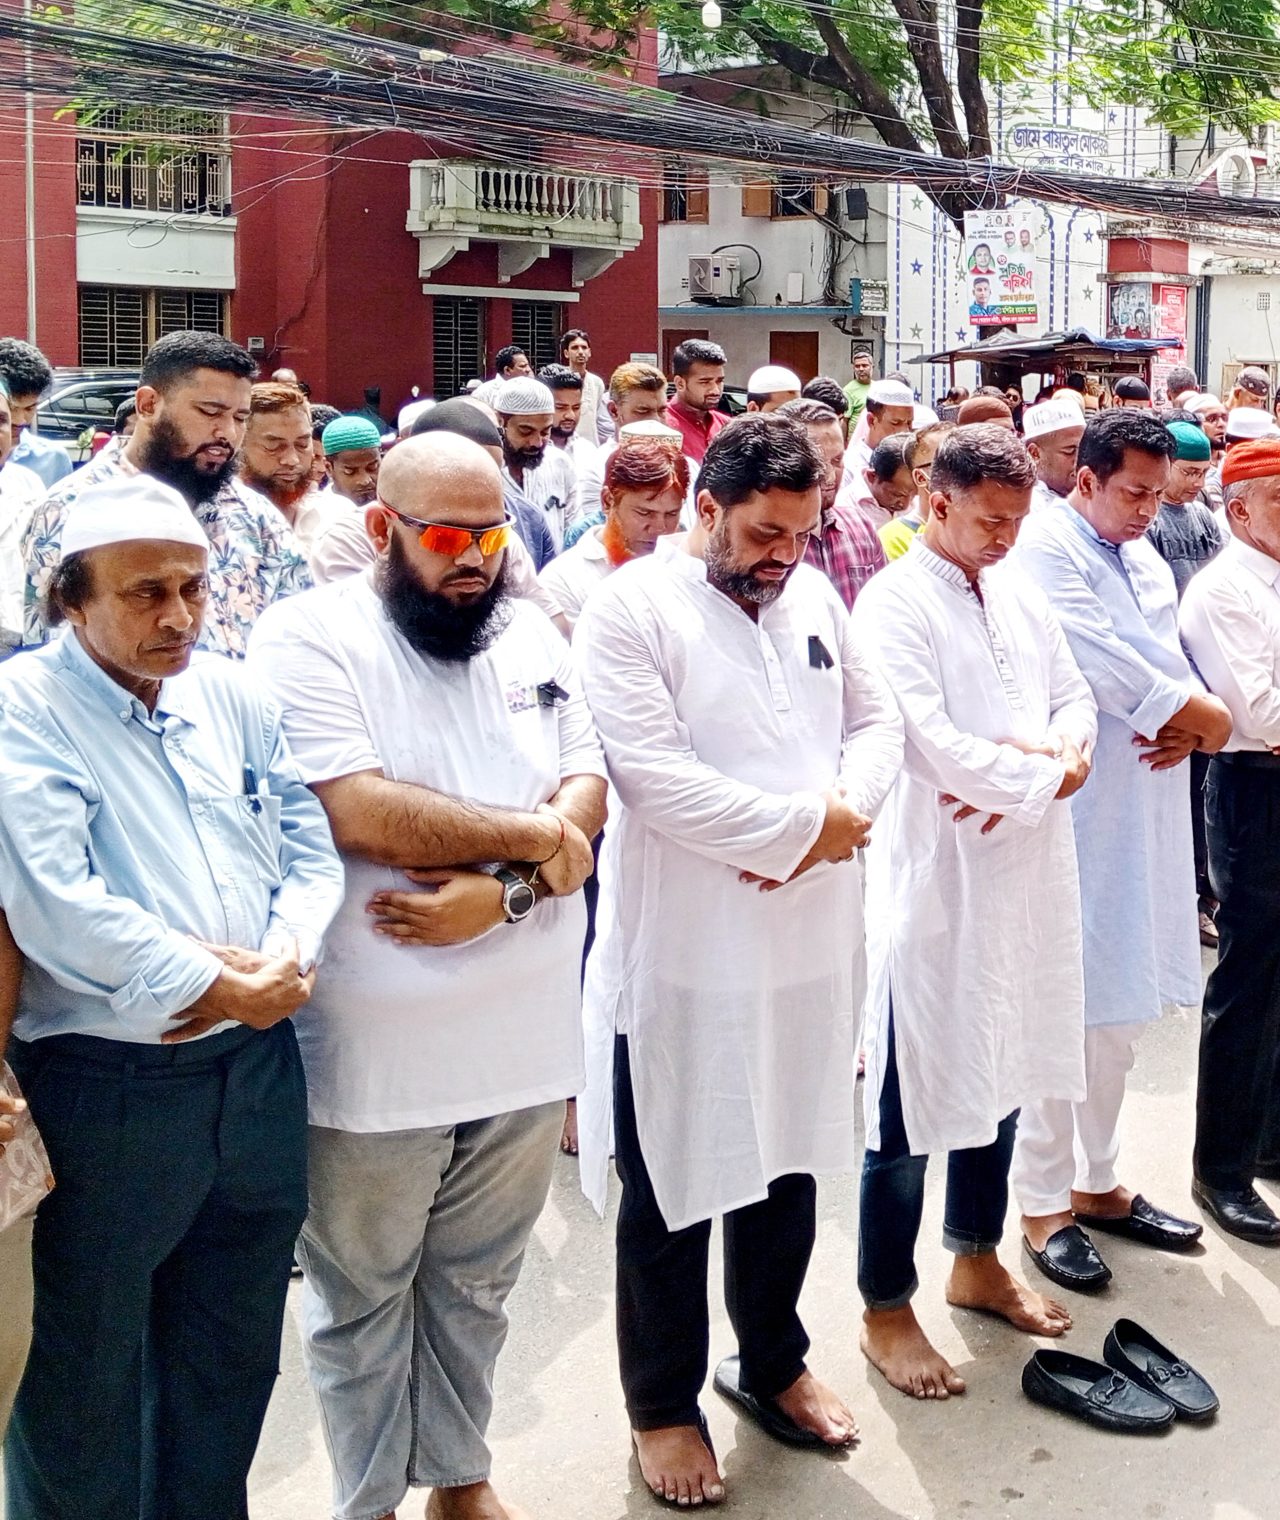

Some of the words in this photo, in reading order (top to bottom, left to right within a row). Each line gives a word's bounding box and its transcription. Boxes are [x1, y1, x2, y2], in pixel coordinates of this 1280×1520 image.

[1014, 128, 1040, 148] জামে
[1042, 129, 1079, 156] বায়তুল
[1059, 154, 1104, 173] বরিশাল
